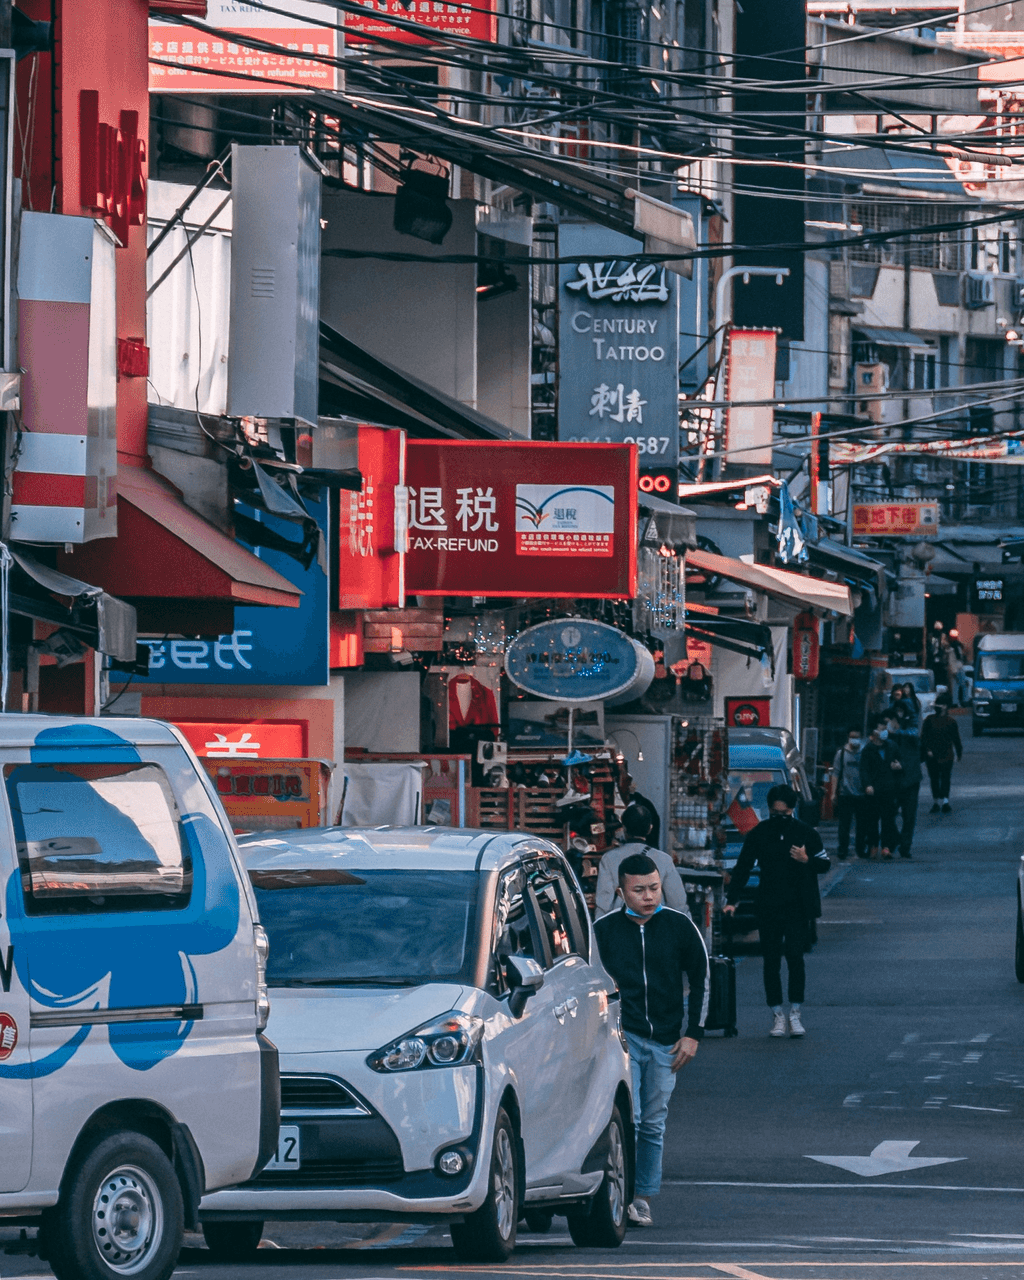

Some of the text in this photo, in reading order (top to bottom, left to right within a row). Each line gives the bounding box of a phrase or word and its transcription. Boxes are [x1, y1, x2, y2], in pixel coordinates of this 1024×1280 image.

[571, 310, 658, 334] CENTURY
[592, 337, 665, 361] TATTOO
[588, 382, 648, 424] 刺青
[407, 537, 499, 552] TAX-REFUND
